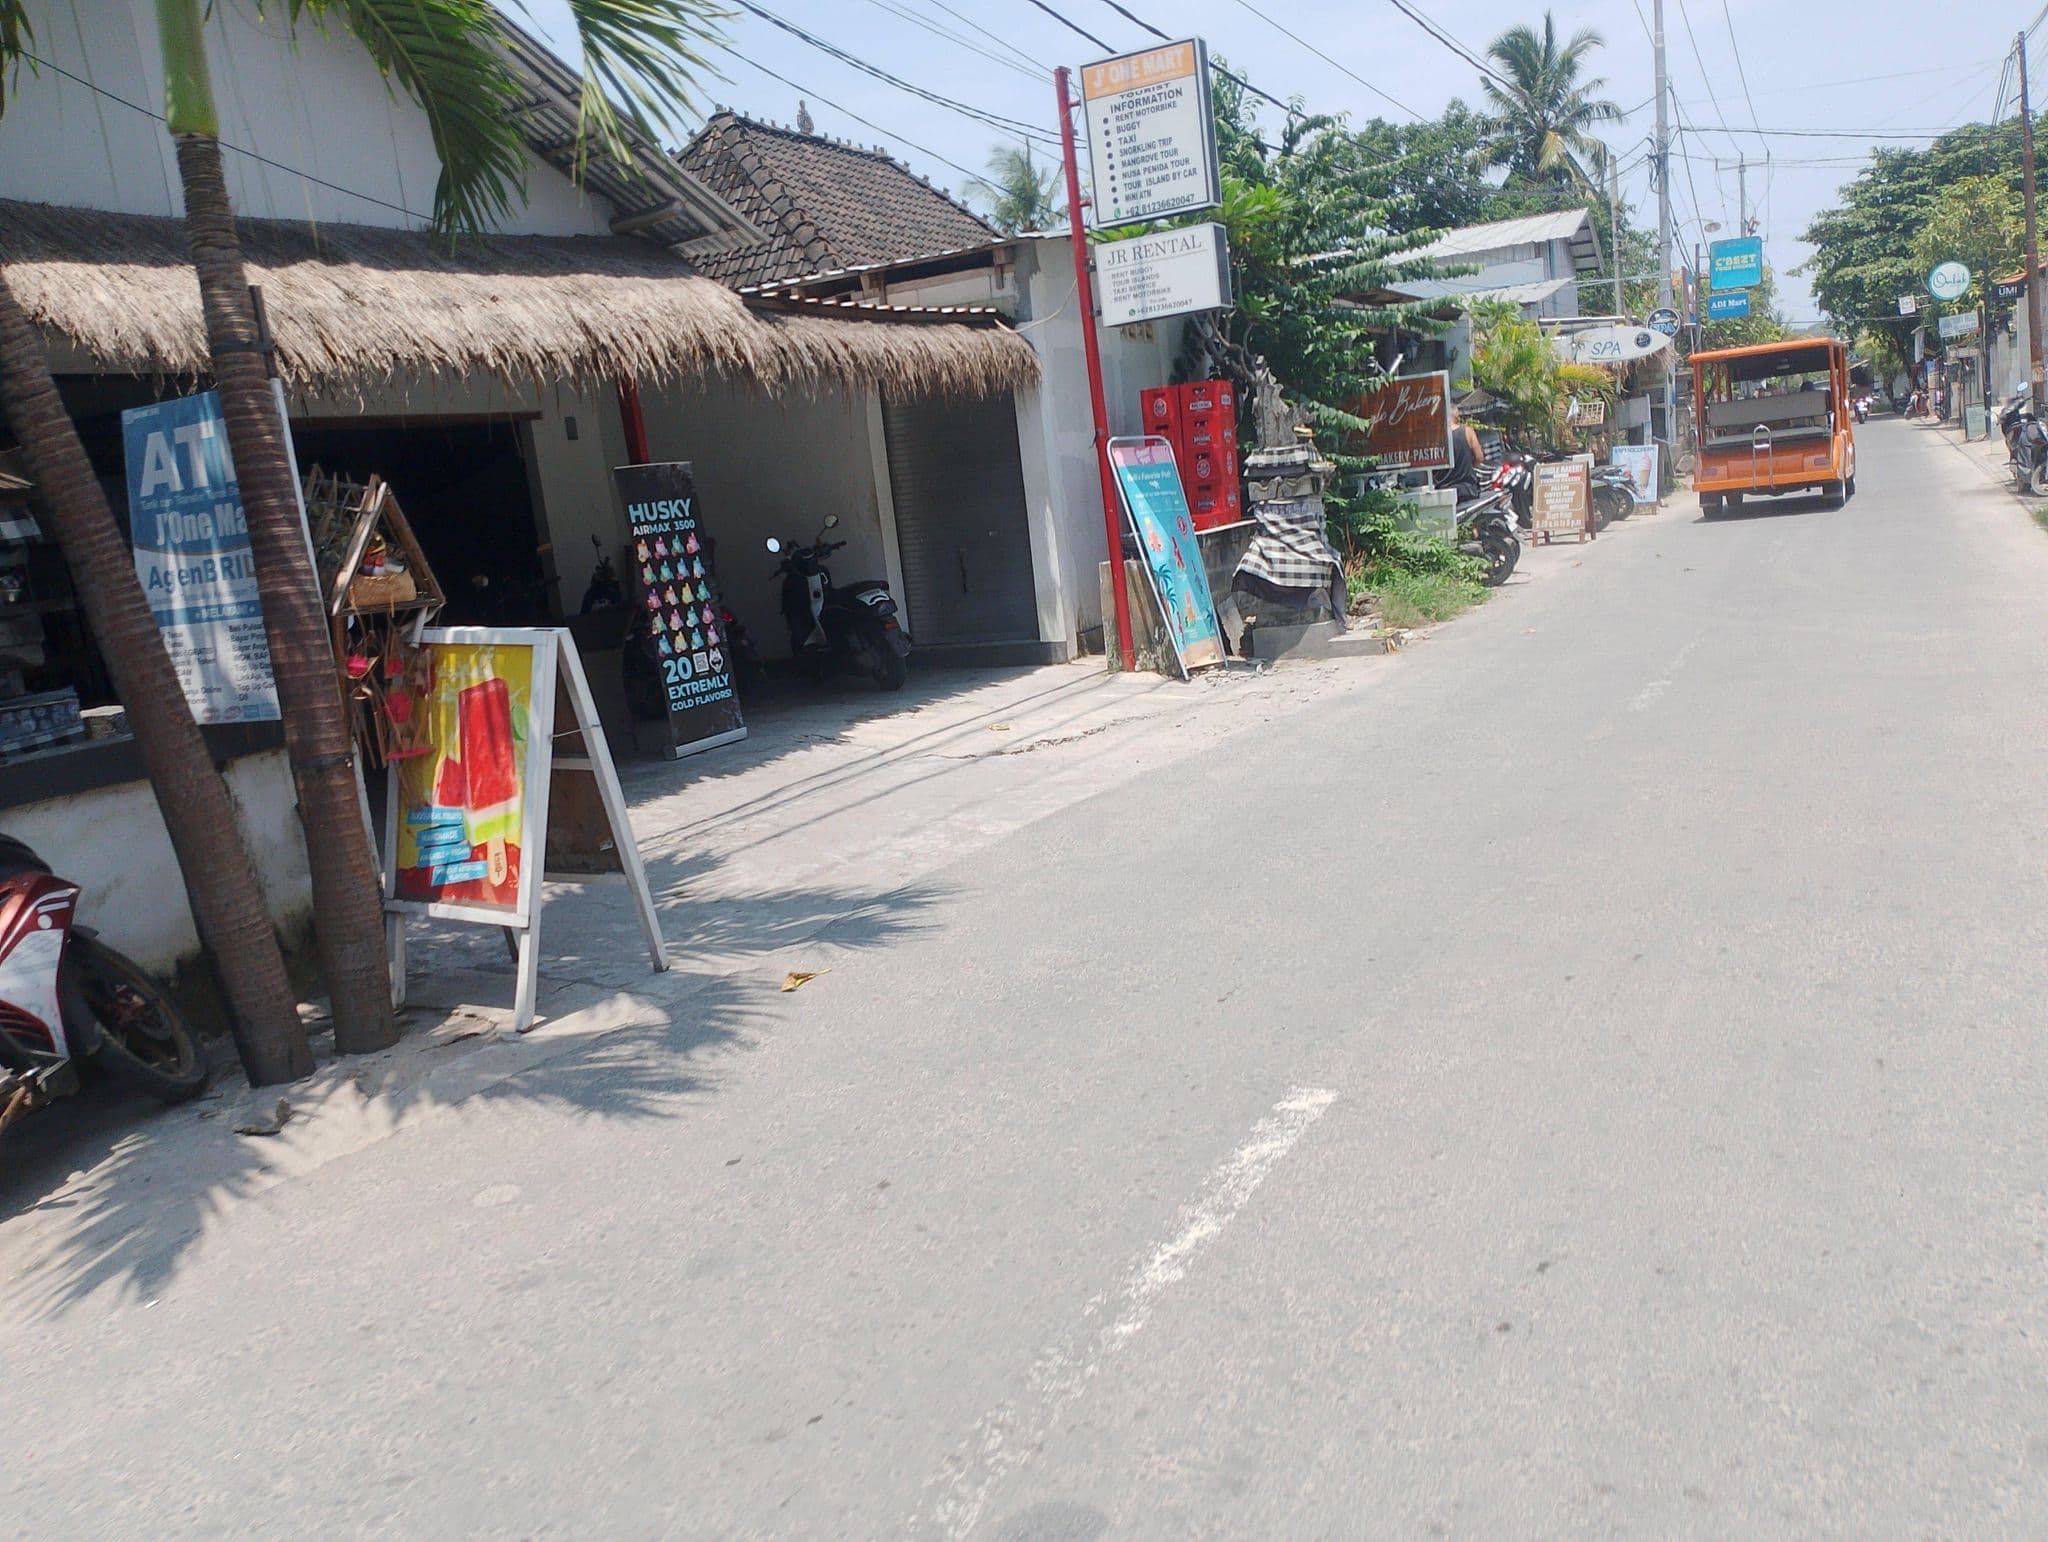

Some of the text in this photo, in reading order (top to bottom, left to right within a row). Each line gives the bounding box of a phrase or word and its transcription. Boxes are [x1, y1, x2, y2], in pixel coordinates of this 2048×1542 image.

[1109, 60, 1139, 84] ONE
[1142, 47, 1185, 77] MART
[1119, 82, 1170, 99] TOURIST
[1110, 87, 1183, 114] INFORMATION
[1115, 101, 1178, 123] RENT MOTORBIKE
[1116, 121, 1141, 134] BUGGY
[1118, 134, 1137, 146] TAXI
[1119, 136, 1173, 157] SNORKLING TRIP
[1121, 148, 1179, 168] MANGROVE TOUR
[1122, 157, 1190, 179] NUSA PENIDA TOUR
[1124, 167, 1198, 192] TOUR ISLAND BY CAR
[1107, 234, 1203, 265] JR RENTAL
[1111, 267, 1154, 280] RENT BUGGY
[1131, 273, 1160, 284] ISLANDS
[1113, 281, 1157, 296] TAXI SERVICE
[1114, 287, 1172, 303] RENT MOTORBIKE
[1710, 301, 1727, 310] ADI
[1728, 299, 1747, 307] Mart
[1591, 341, 1621, 356] SPA
[1413, 447, 1446, 461] PASTRY
[214, 503, 248, 536] Ma
[628, 498, 691, 523] HUSKY
[633, 519, 696, 536] AIRMAX 3500
[662, 656, 692, 684] 20
[668, 673, 729, 700] EXTREMLY
[671, 698, 694, 711] COLD
